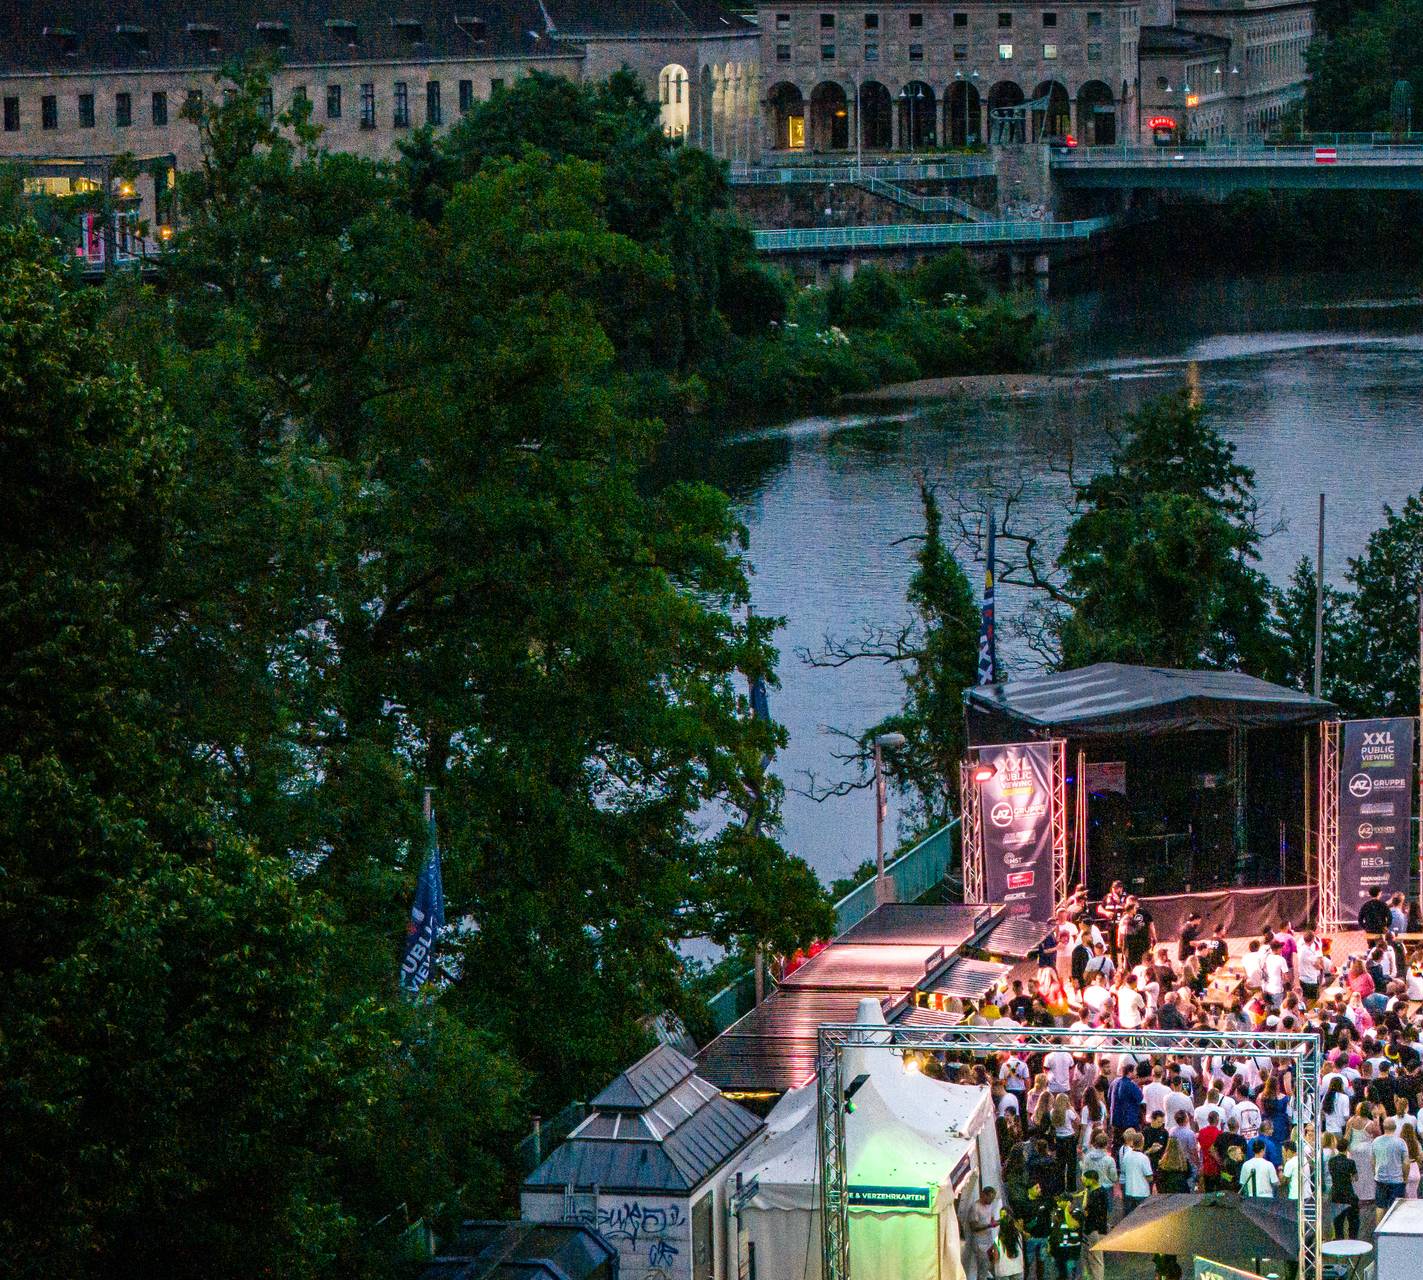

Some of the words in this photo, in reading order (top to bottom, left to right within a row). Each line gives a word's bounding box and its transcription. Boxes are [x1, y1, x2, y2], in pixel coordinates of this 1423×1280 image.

[1362, 732, 1394, 745] XXL
[1361, 746, 1395, 754] PUBLIC
[999, 771, 1033, 781] PUBLIC
[1000, 781, 1033, 789] VIEWING
[1353, 780, 1369, 790] AZ
[996, 809, 1010, 819] AZ
[1013, 805, 1046, 814] GRUPPE
[862, 1192, 926, 1200] VERZEHRKARTEN
